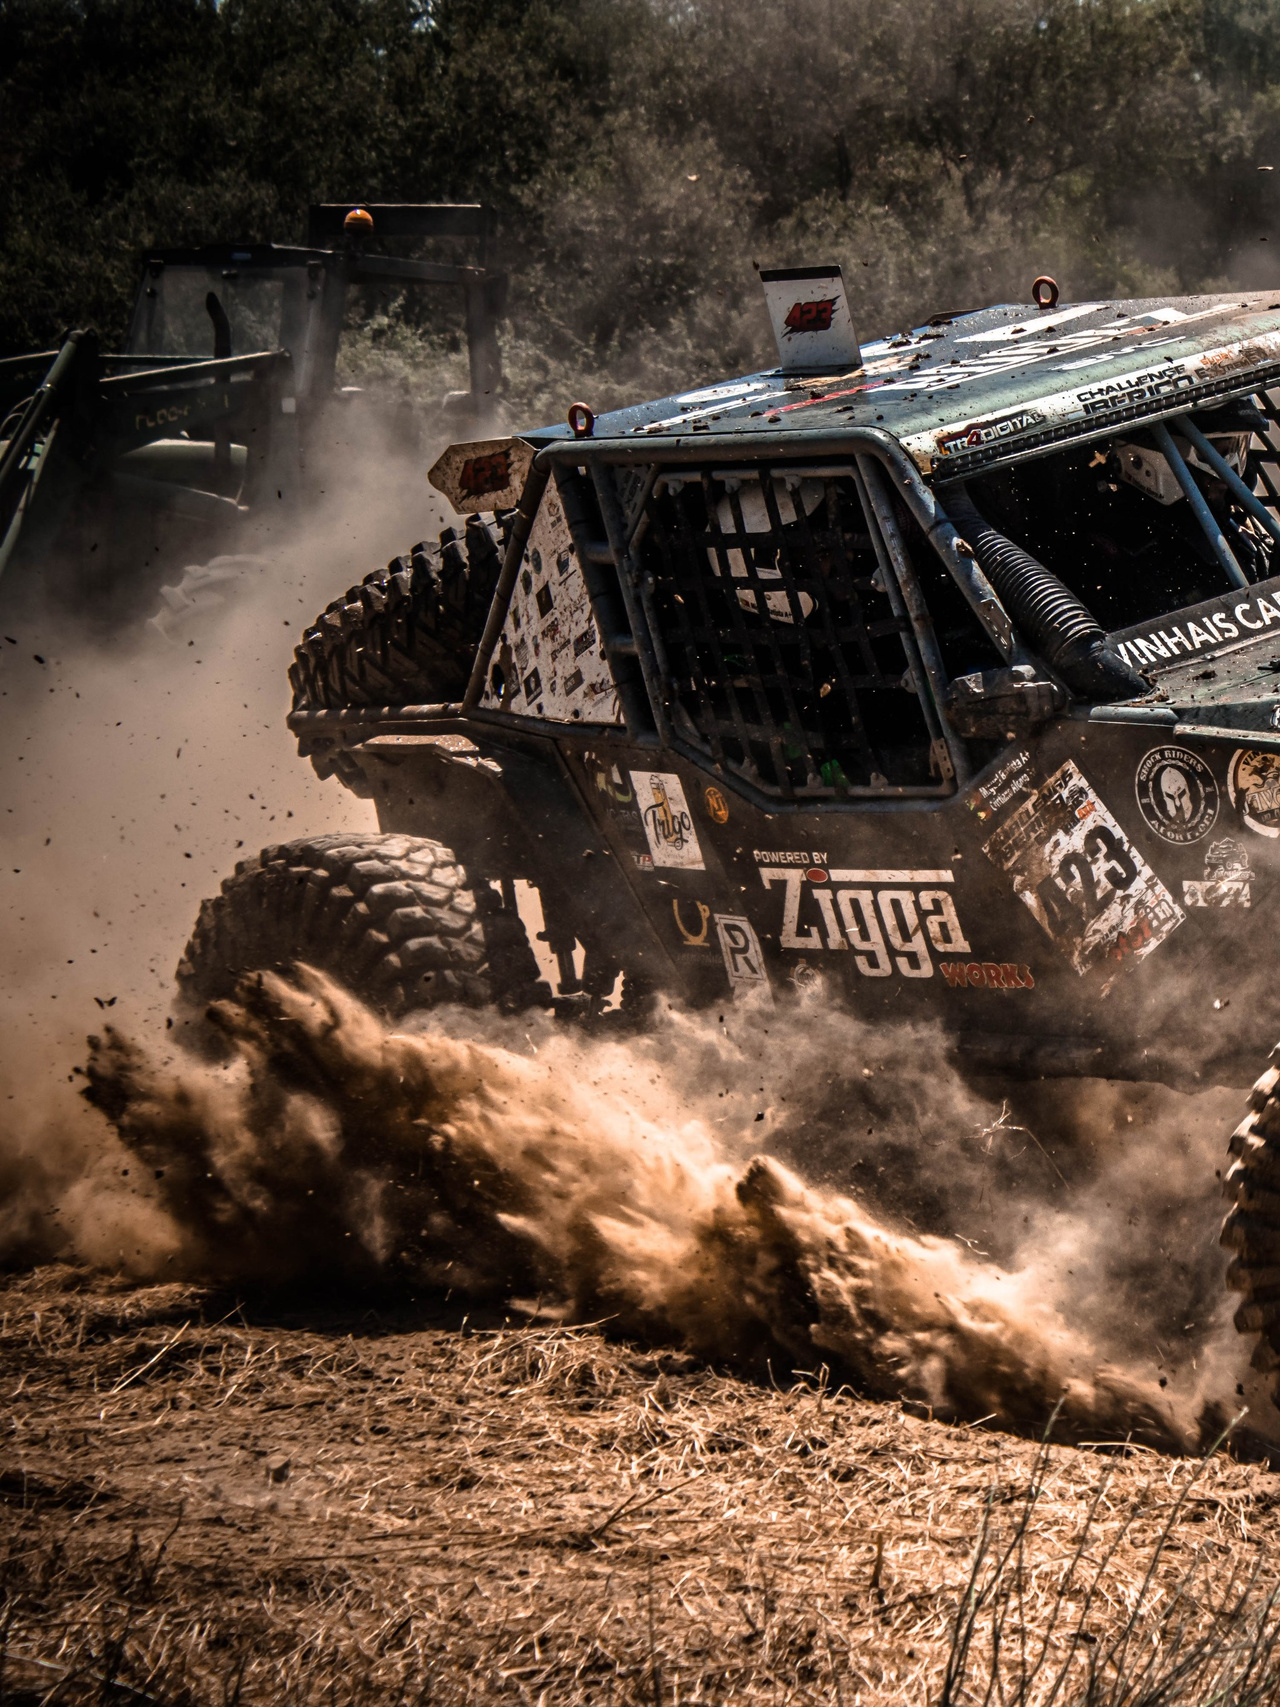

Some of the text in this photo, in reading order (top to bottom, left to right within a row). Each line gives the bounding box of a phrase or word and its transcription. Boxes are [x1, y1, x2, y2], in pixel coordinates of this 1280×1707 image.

[785, 300, 833, 331] 423
[1076, 364, 1186, 403] CHALLENGE
[1113, 611, 1240, 669] VINHAIS
[1140, 749, 1204, 782] SHOCK RIDERS
[754, 850, 828, 865] POWERED BY
[758, 867, 973, 979] Zigga
[939, 961, 1035, 989] WORKS
